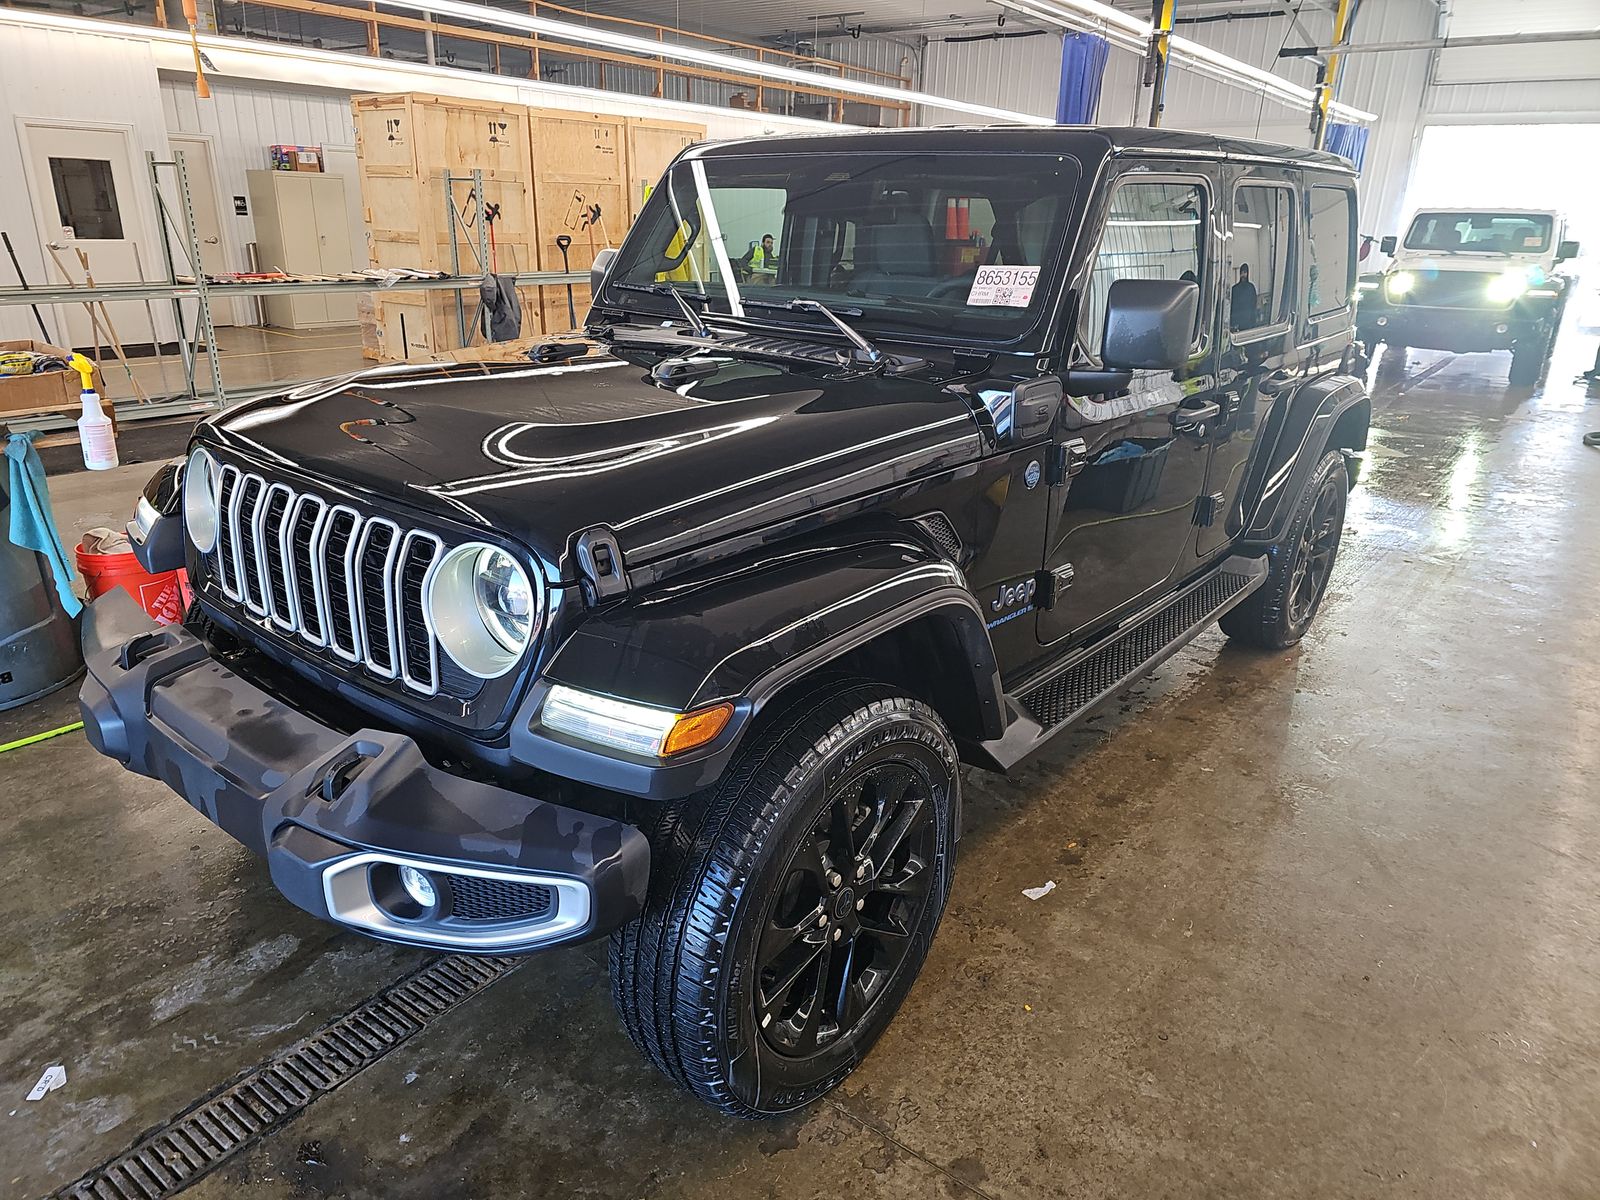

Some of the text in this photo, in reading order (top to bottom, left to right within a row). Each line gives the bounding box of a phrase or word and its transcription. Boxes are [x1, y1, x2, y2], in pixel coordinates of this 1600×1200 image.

[977, 270, 1038, 286] 8653155
[151, 584, 173, 610] THE
[991, 578, 1036, 612] Jeep
[986, 607, 1027, 629] WRANGLER
